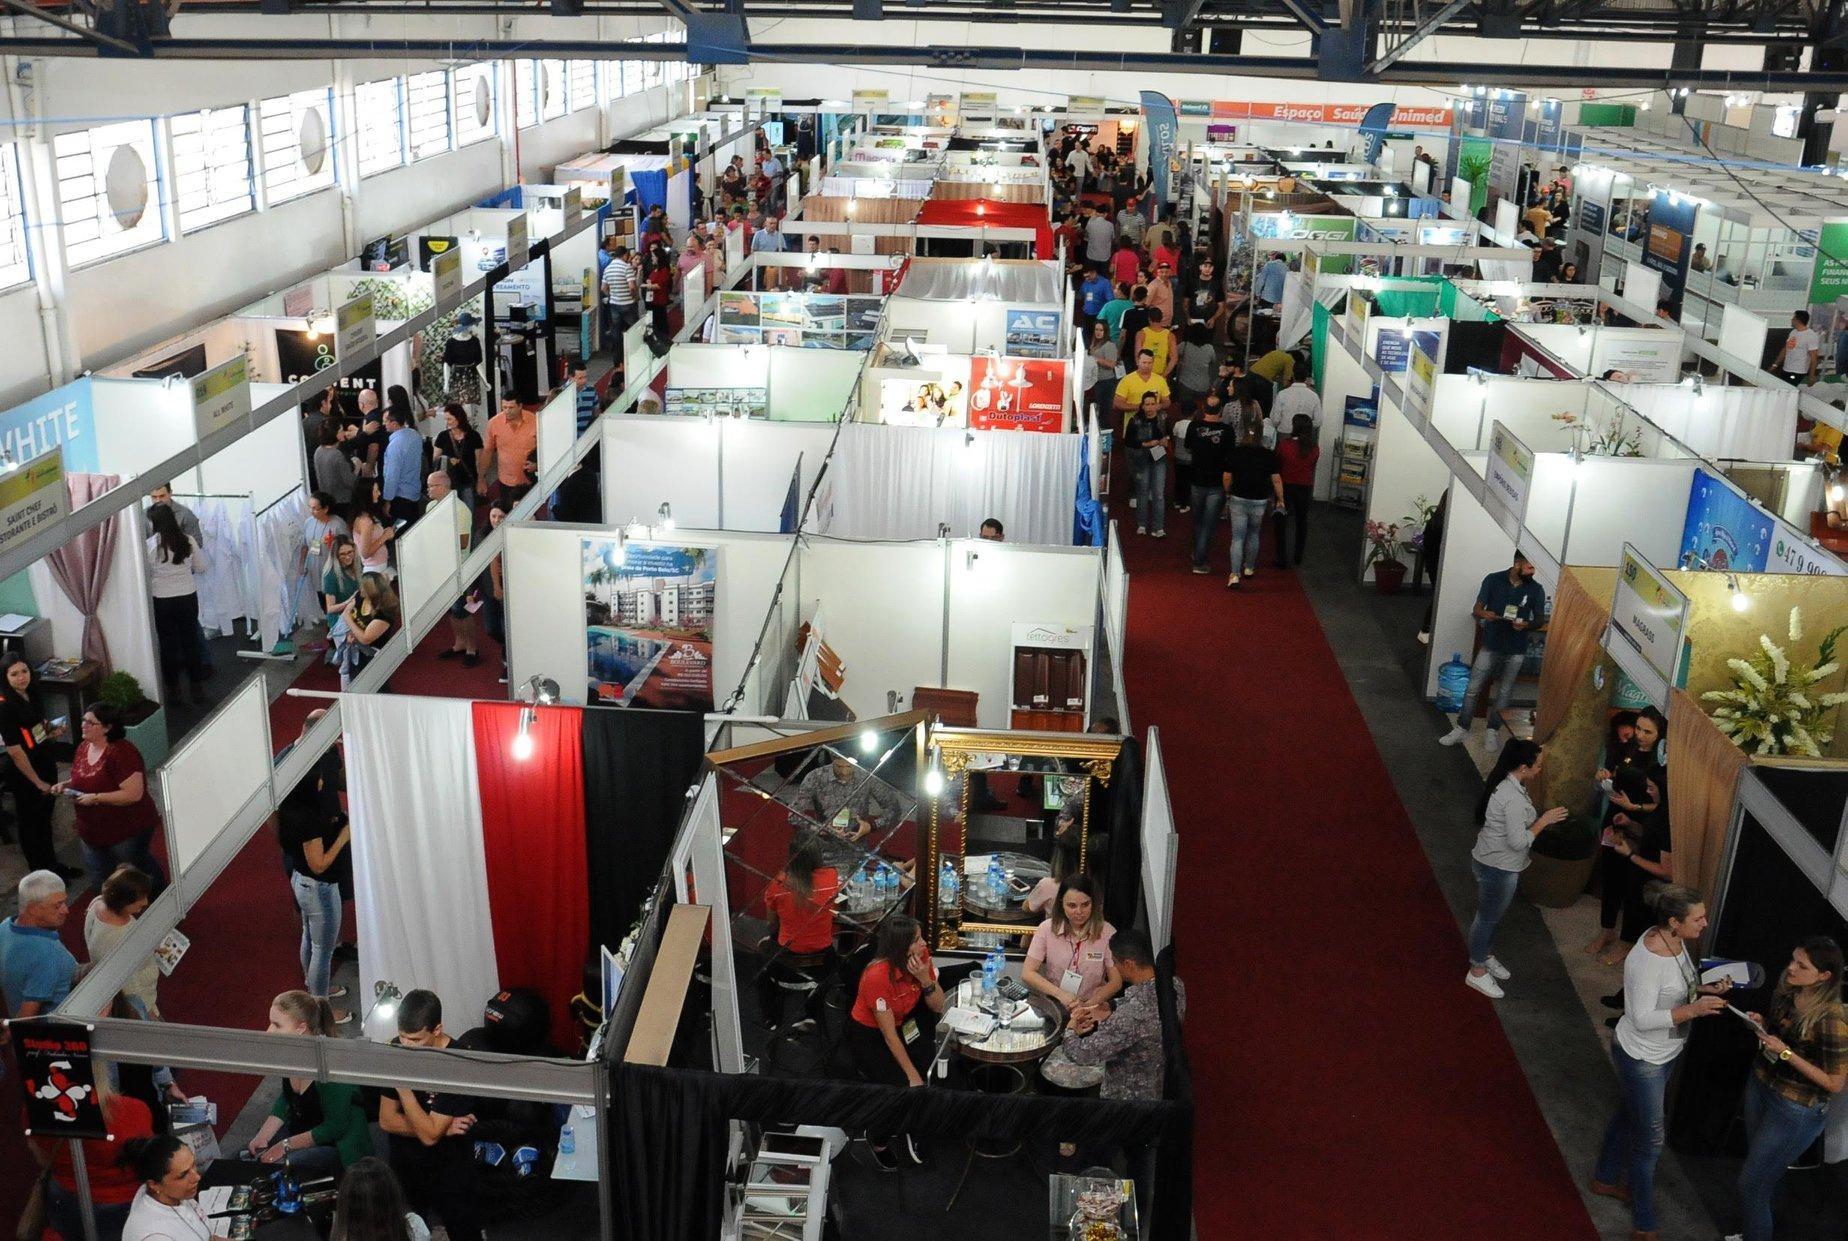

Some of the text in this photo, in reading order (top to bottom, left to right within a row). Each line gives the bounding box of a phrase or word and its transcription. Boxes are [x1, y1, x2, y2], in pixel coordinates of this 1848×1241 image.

[1274, 106, 1322, 120] Espaço
[1290, 229, 1349, 241] OGGI
[1011, 314, 1056, 329] AC
[288, 373, 376, 389] COENT
[989, 411, 1043, 423] Dutoplast
[7, 499, 42, 527] SAINT CHEF
[1784, 545, 1796, 567] 47
[1796, 557, 1804, 573] 9
